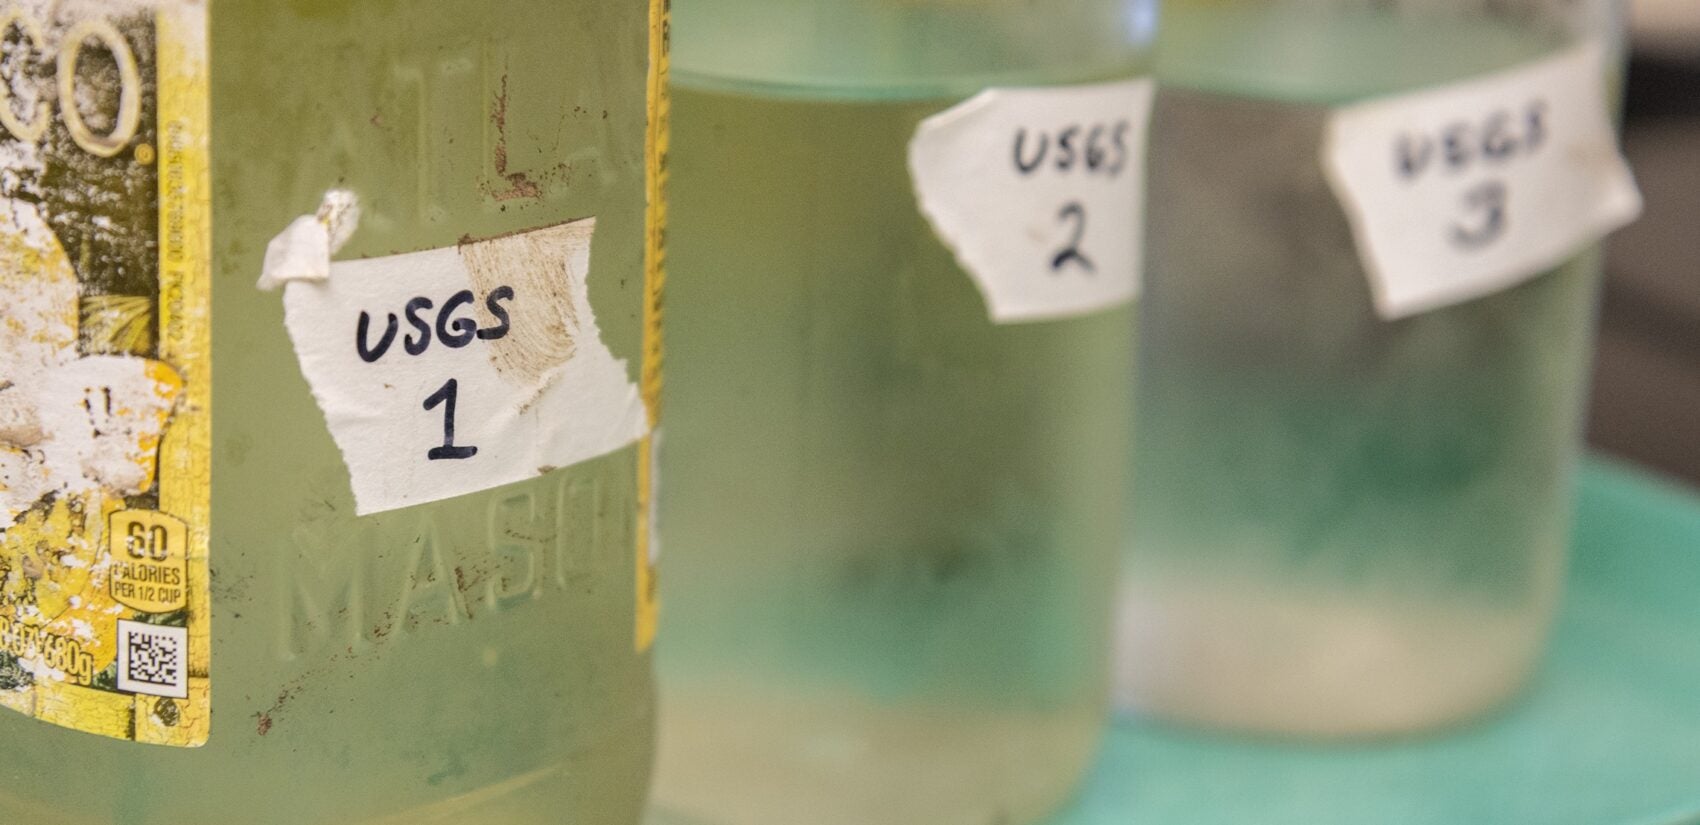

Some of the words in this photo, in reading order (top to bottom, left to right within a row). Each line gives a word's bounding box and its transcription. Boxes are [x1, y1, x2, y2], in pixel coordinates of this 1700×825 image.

[1012, 120, 1130, 178] USGS
[1393, 98, 1550, 184] USGS
[1050, 200, 1098, 274] 2
[1449, 178, 1508, 250] 3
[356, 285, 514, 363] USGS
[423, 378, 478, 460] 1
[126, 521, 168, 563] 60
[114, 581, 135, 599] PER
[138, 585, 155, 602] 1/2
[158, 587, 181, 604] CUP
